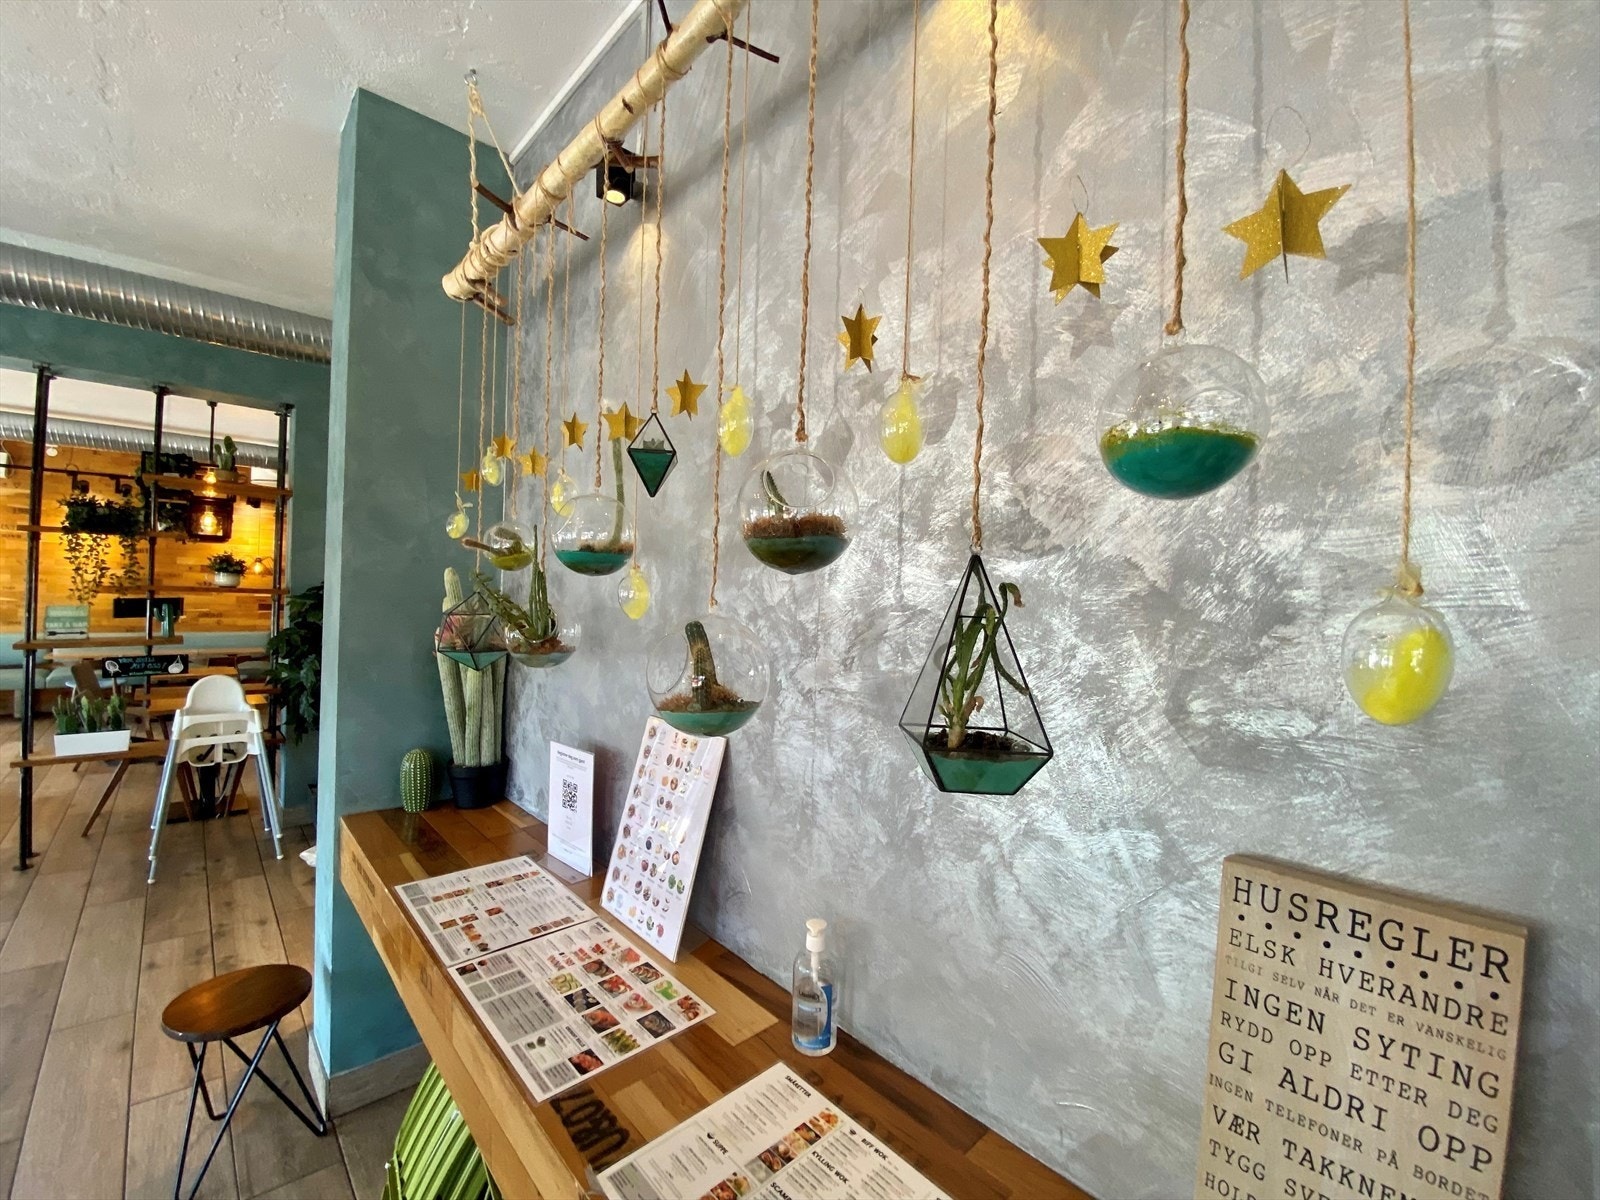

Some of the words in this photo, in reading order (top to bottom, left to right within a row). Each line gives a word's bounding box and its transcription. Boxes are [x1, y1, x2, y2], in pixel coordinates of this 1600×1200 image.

[1232, 876, 1511, 984] HUSREGLER
[1225, 954, 1263, 976] TILGI
[1272, 972, 1305, 990] SELV
[1314, 986, 1341, 1004] NÅR
[1349, 999, 1377, 1016] DET
[1387, 1011, 1406, 1027] ER
[1416, 1021, 1508, 1061] VANSKELIG
[1228, 927, 1296, 967] ELSK
[1318, 957, 1508, 1036] HVERANDRE
[1220, 1010, 1274, 1044] RYDD
[1289, 1039, 1332, 1068] OPP
[1350, 1062, 1428, 1108] ETTER
[1447, 1099, 1499, 1134] DEG
[1224, 977, 1326, 1035] INGEN
[1352, 1026, 1500, 1099] SYTING
[712, 1139, 729, 1155] SUPPE
[874, 1147, 888, 1160] WOK
[1208, 1073, 1254, 1103] INGEN
[1265, 1099, 1363, 1154] TELEFONER
[1376, 1149, 1400, 1170] PÅ
[1212, 1104, 1261, 1145] VÆR
[1218, 1041, 1255, 1074] GI
[1277, 1066, 1389, 1132] ALDRI
[1417, 1125, 1493, 1173] OPP
[812, 1150, 835, 1171] KYLLING
[834, 1170, 849, 1184] WOK
[1209, 1138, 1266, 1182] TYGG
